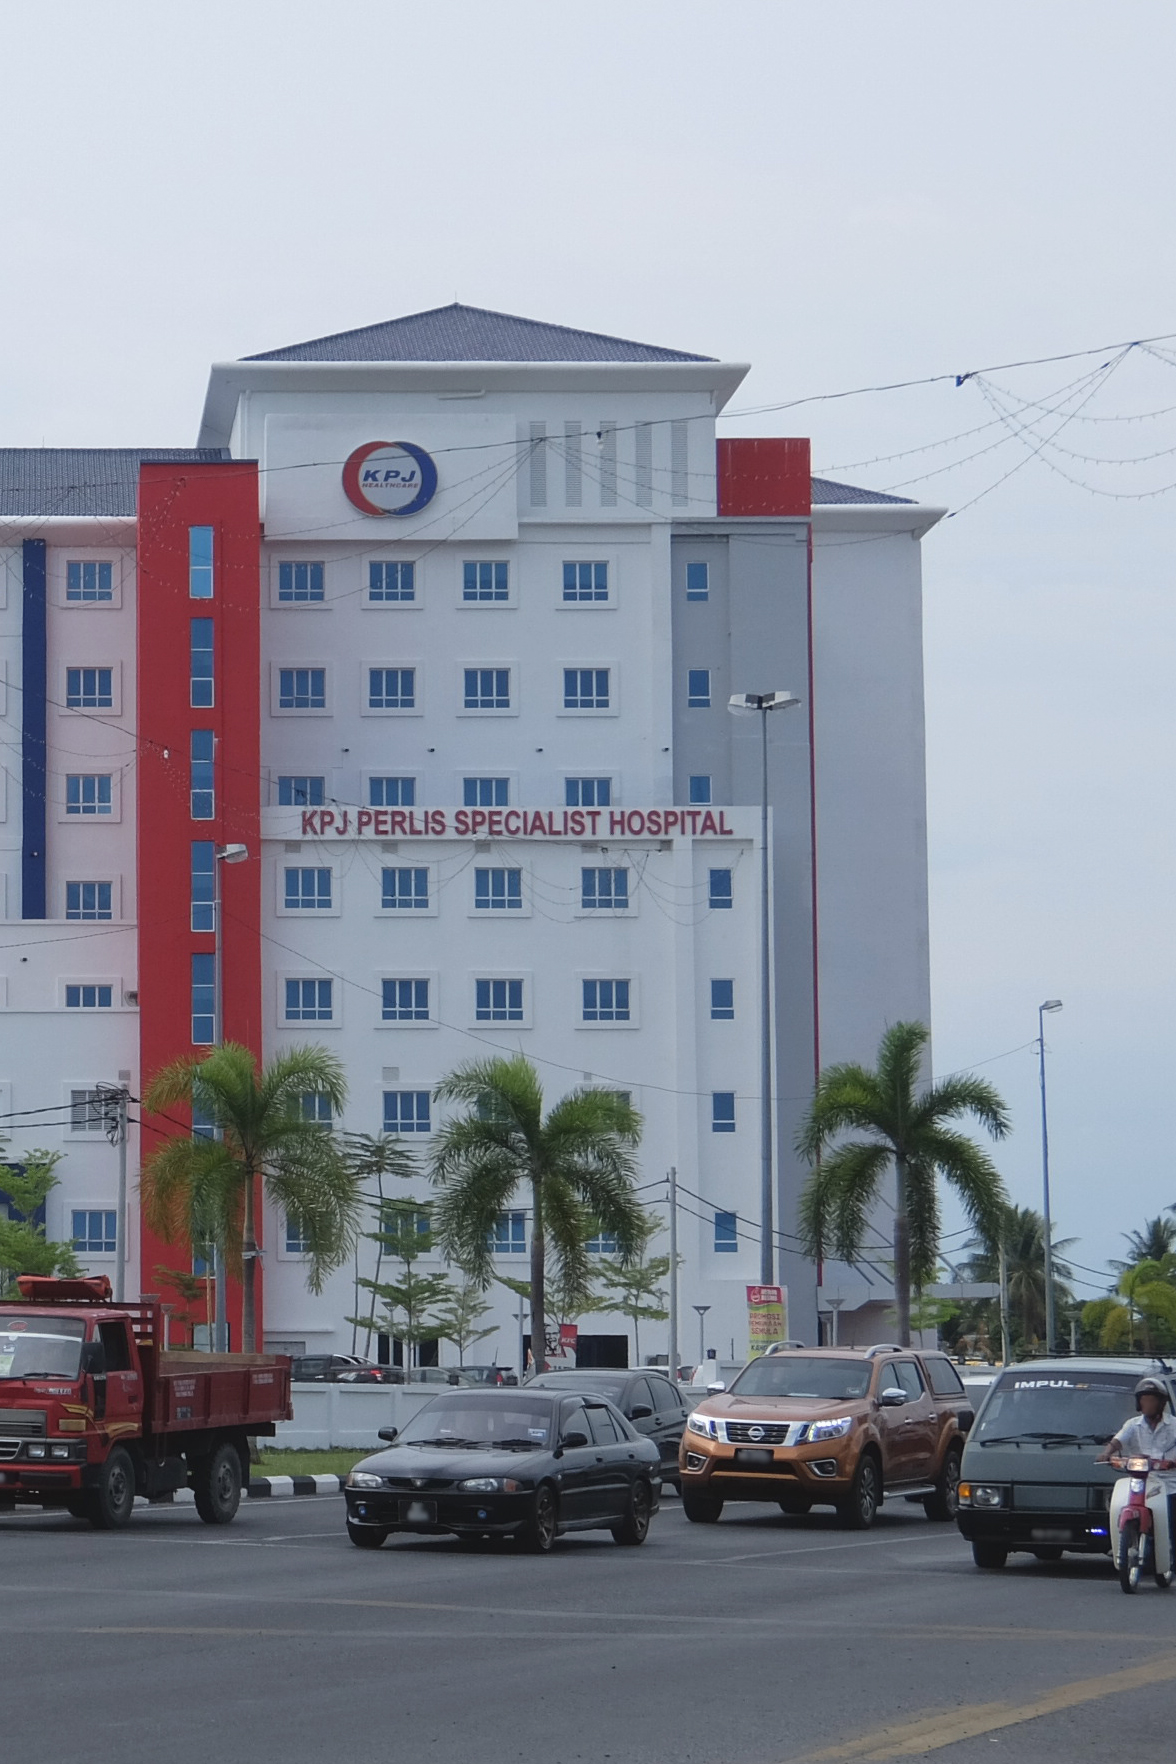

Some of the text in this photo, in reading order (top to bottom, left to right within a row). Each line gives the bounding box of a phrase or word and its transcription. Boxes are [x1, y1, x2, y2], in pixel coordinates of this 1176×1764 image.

[363, 469, 416, 482] KPJ
[301, 810, 734, 835] KPJ PERLIS SPECIALIST HOSPITAL
